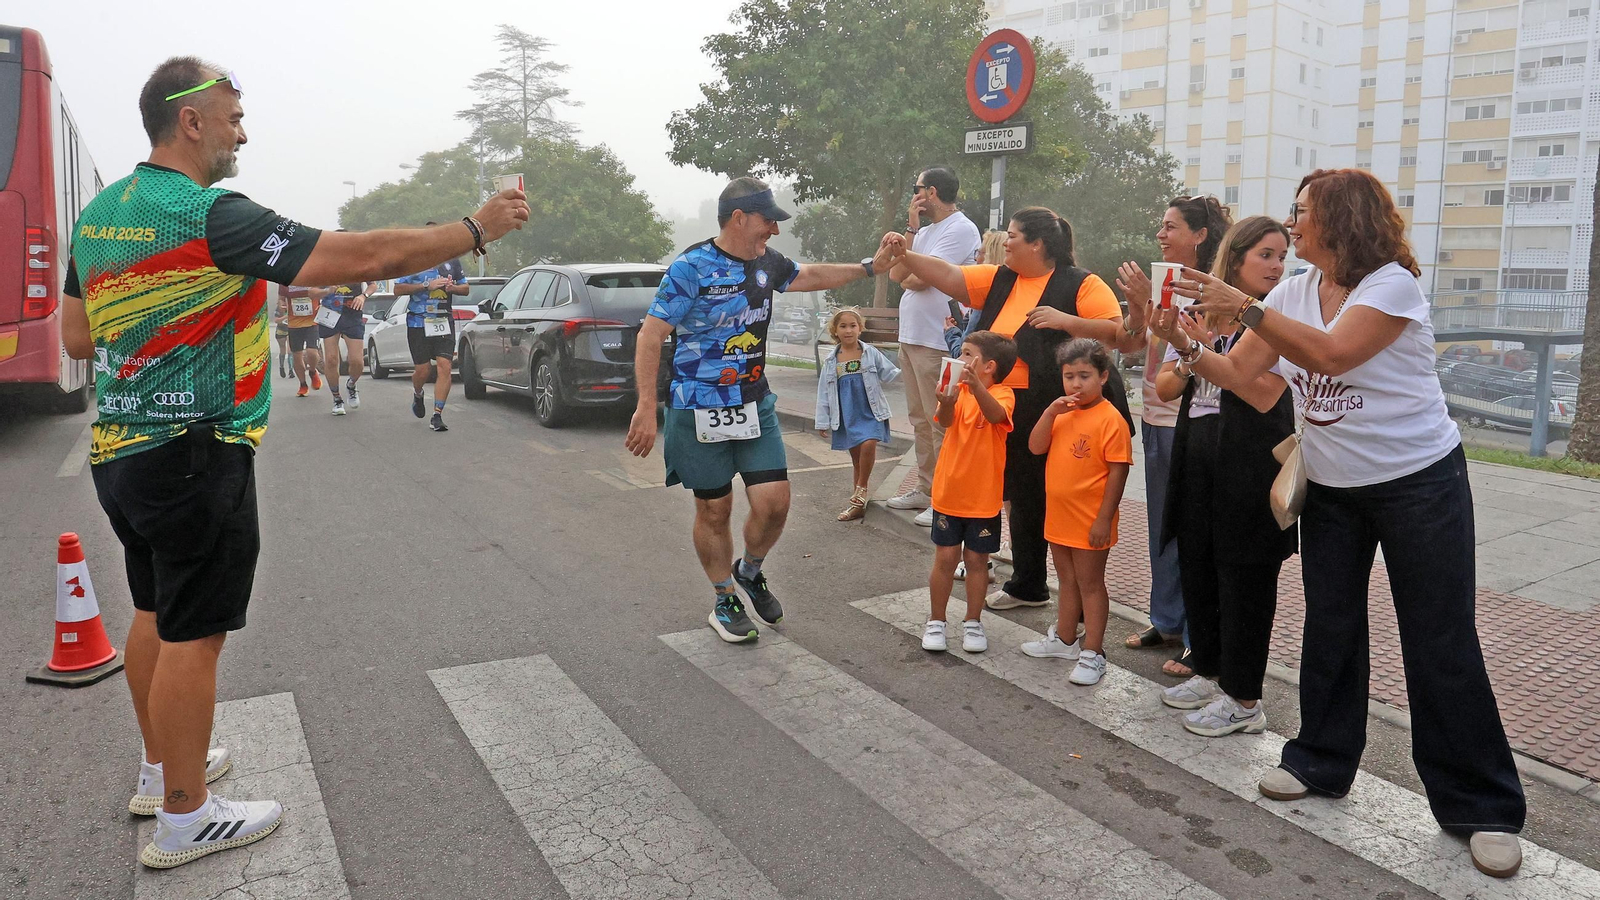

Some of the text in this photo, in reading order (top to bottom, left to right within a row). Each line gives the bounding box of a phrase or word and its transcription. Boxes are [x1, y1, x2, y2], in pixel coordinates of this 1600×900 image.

[986, 57, 1010, 67] EXCEPTO
[977, 129, 1013, 140] EXCEPTO
[967, 139, 1022, 152] MINUSVALIDO
[81, 225, 155, 241] PILAR 2025
[295, 304, 309, 312] 284
[325, 311, 330, 319] 1
[433, 323, 445, 333] 30
[146, 410, 173, 419] Solera
[175, 411, 204, 419] Motor
[707, 406, 748, 428] 335
